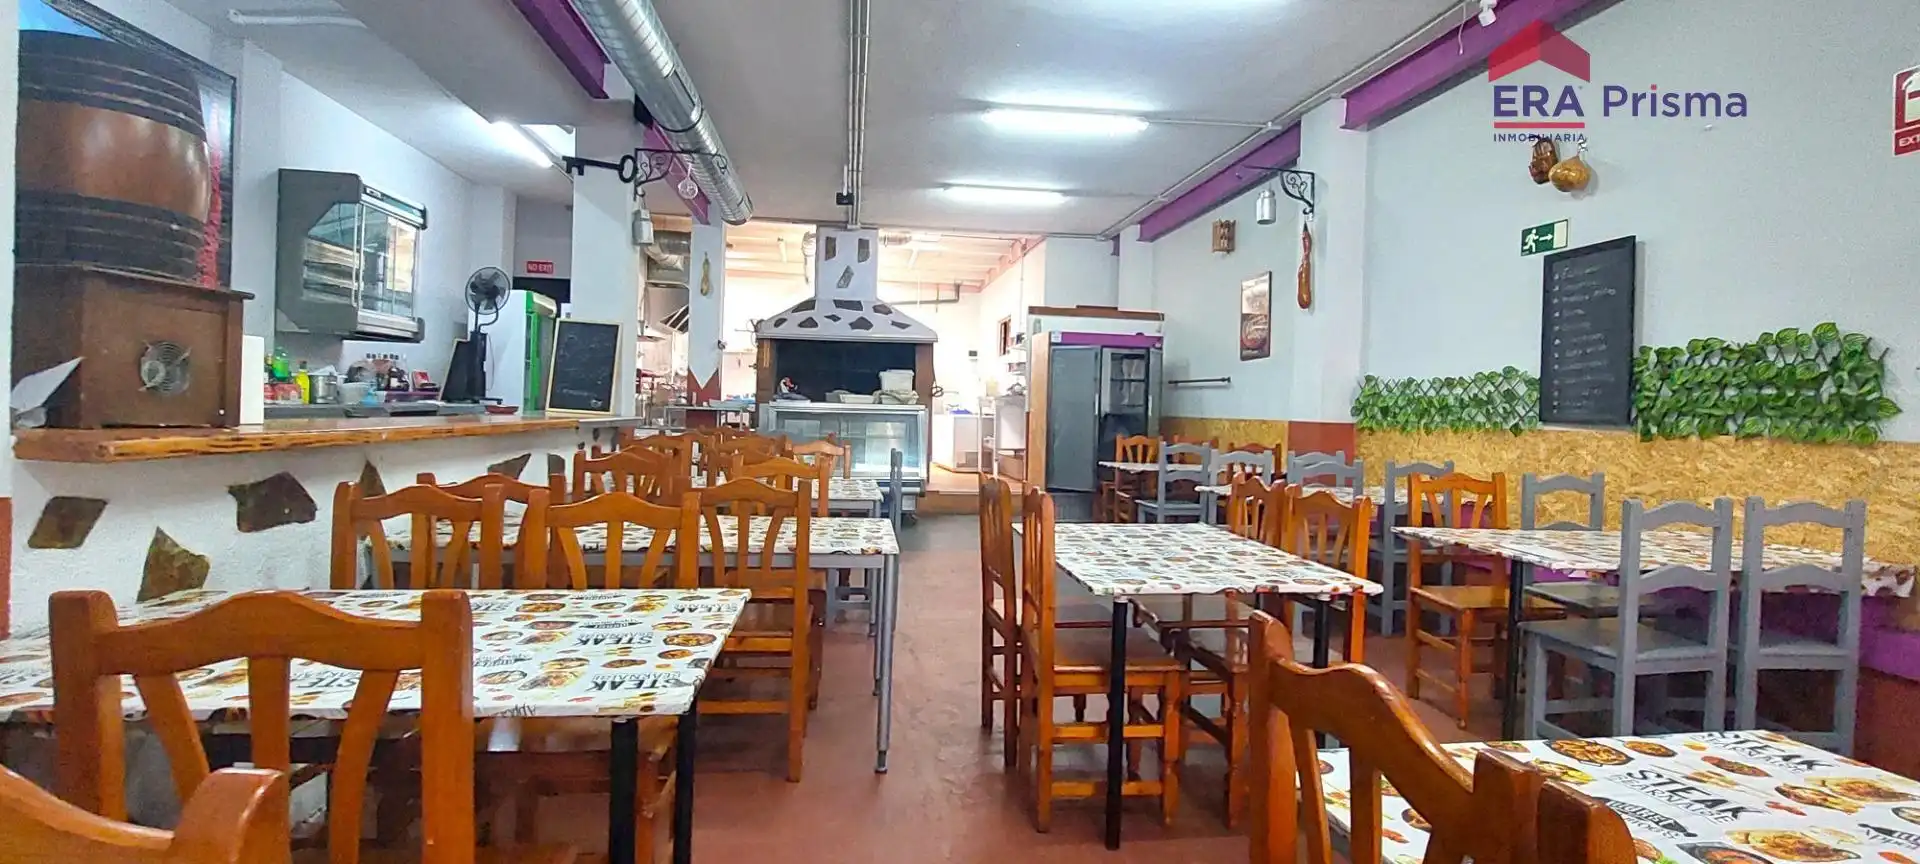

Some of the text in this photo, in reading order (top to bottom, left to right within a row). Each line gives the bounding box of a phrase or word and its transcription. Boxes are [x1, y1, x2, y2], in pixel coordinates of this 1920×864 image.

[527, 262, 553, 272] NO EXIT
[573, 636, 652, 646] STEAK
[1626, 769, 1766, 821] STEAK
